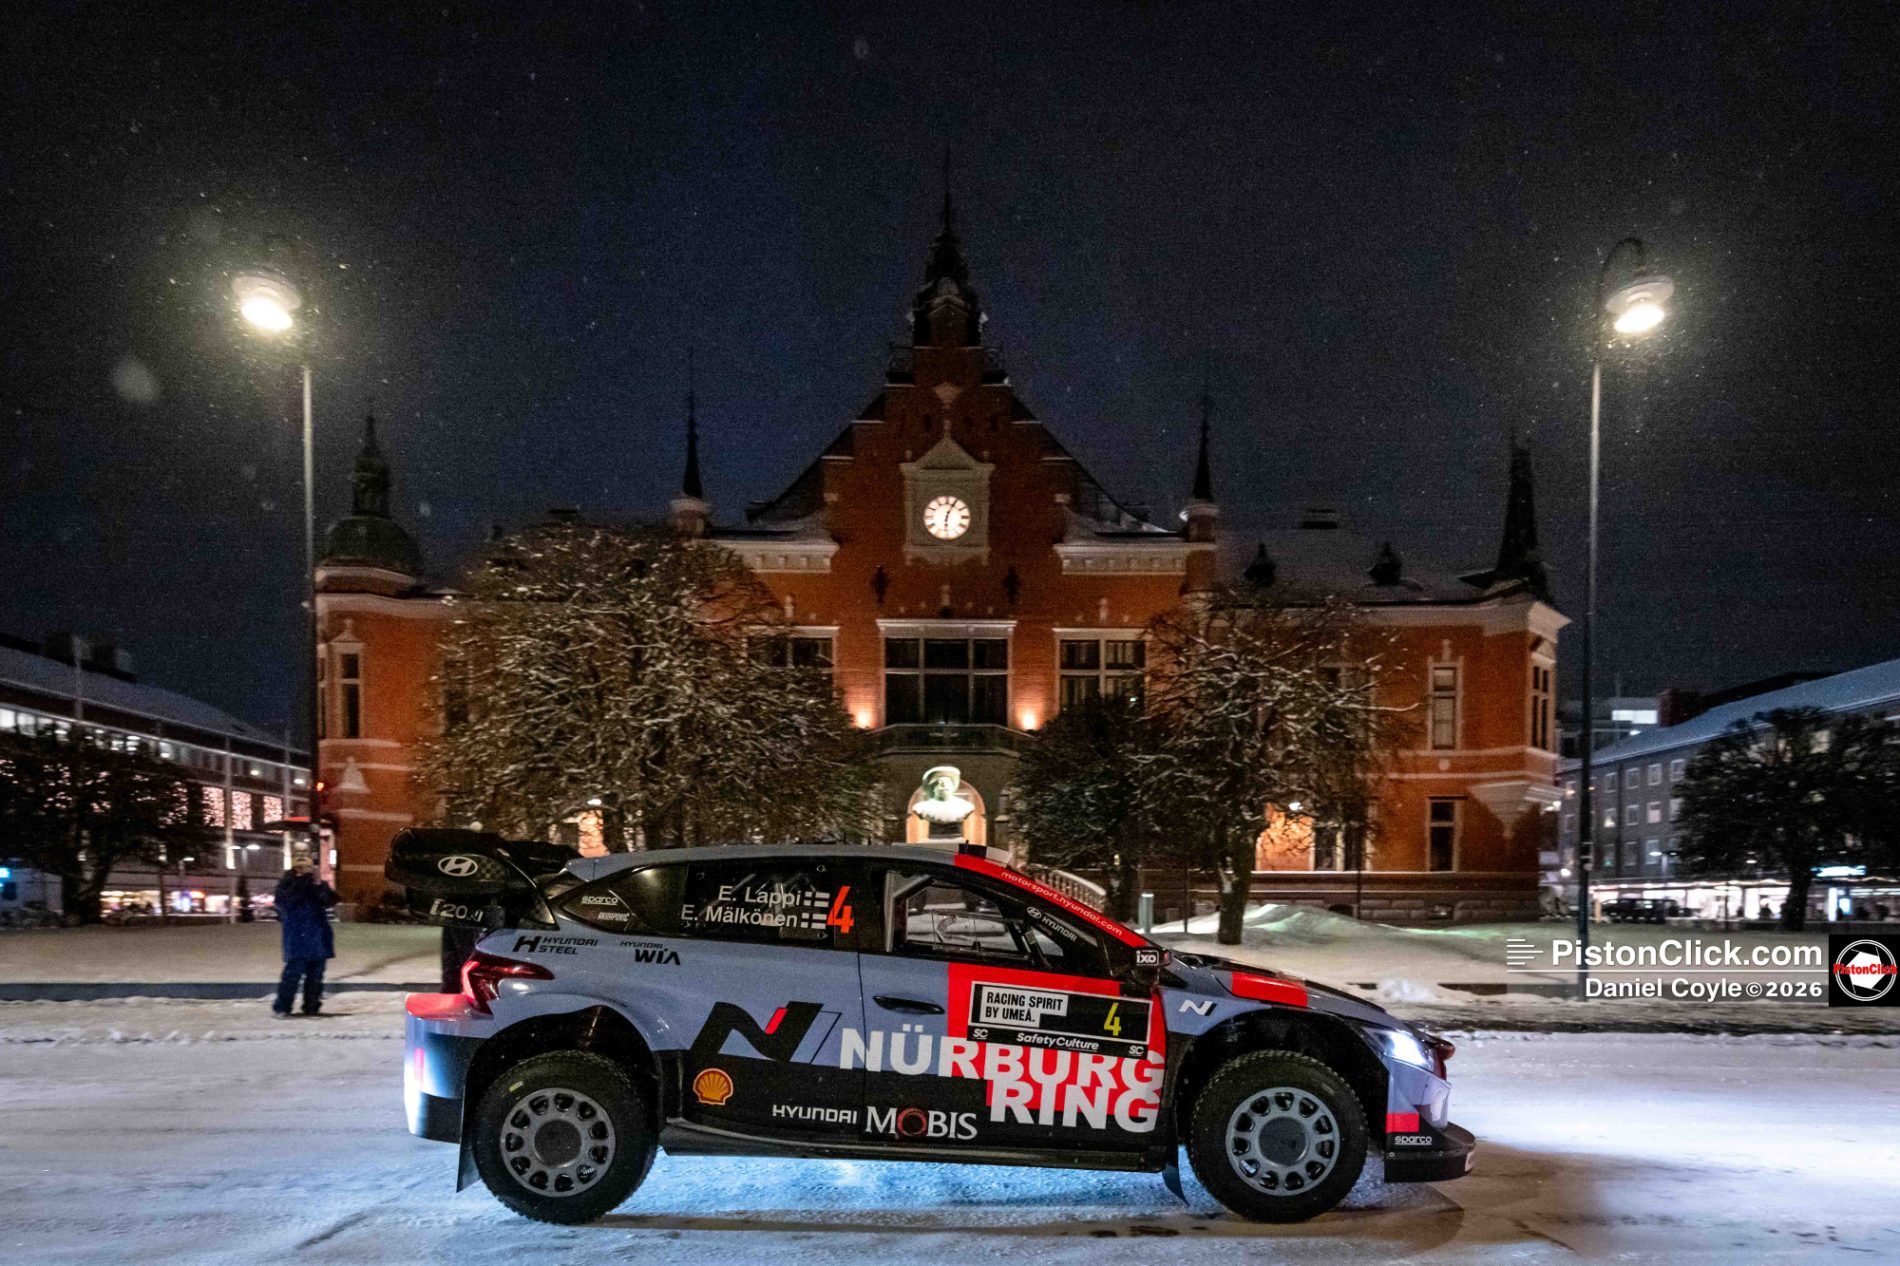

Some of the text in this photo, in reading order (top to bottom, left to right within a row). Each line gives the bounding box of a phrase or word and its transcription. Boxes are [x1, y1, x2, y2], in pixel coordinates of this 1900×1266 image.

[581, 895, 619, 906] sparco
[718, 885, 801, 909] E. Lappi
[1001, 871, 1123, 936] motorsport.hyundai.com
[681, 904, 798, 928] E. Mälkönen
[826, 885, 855, 934] 4
[1041, 916, 1078, 942] HYUNDAI
[538, 946, 578, 955] STEEL
[541, 936, 598, 948] HYUNDAI
[620, 941, 663, 949] HYUNDAI
[985, 1006, 999, 1019] BY
[986, 991, 1063, 1012] RACING SPIRIT
[1103, 1002, 1122, 1037] 4
[973, 1028, 1144, 1056] SC SafetyCulture SC
[839, 1024, 1167, 1091] NÜRBURG
[989, 1078, 1163, 1133] RING
[772, 1104, 978, 1140] HYUNDAI MOBIS
[1394, 1135, 1432, 1146] sparco
